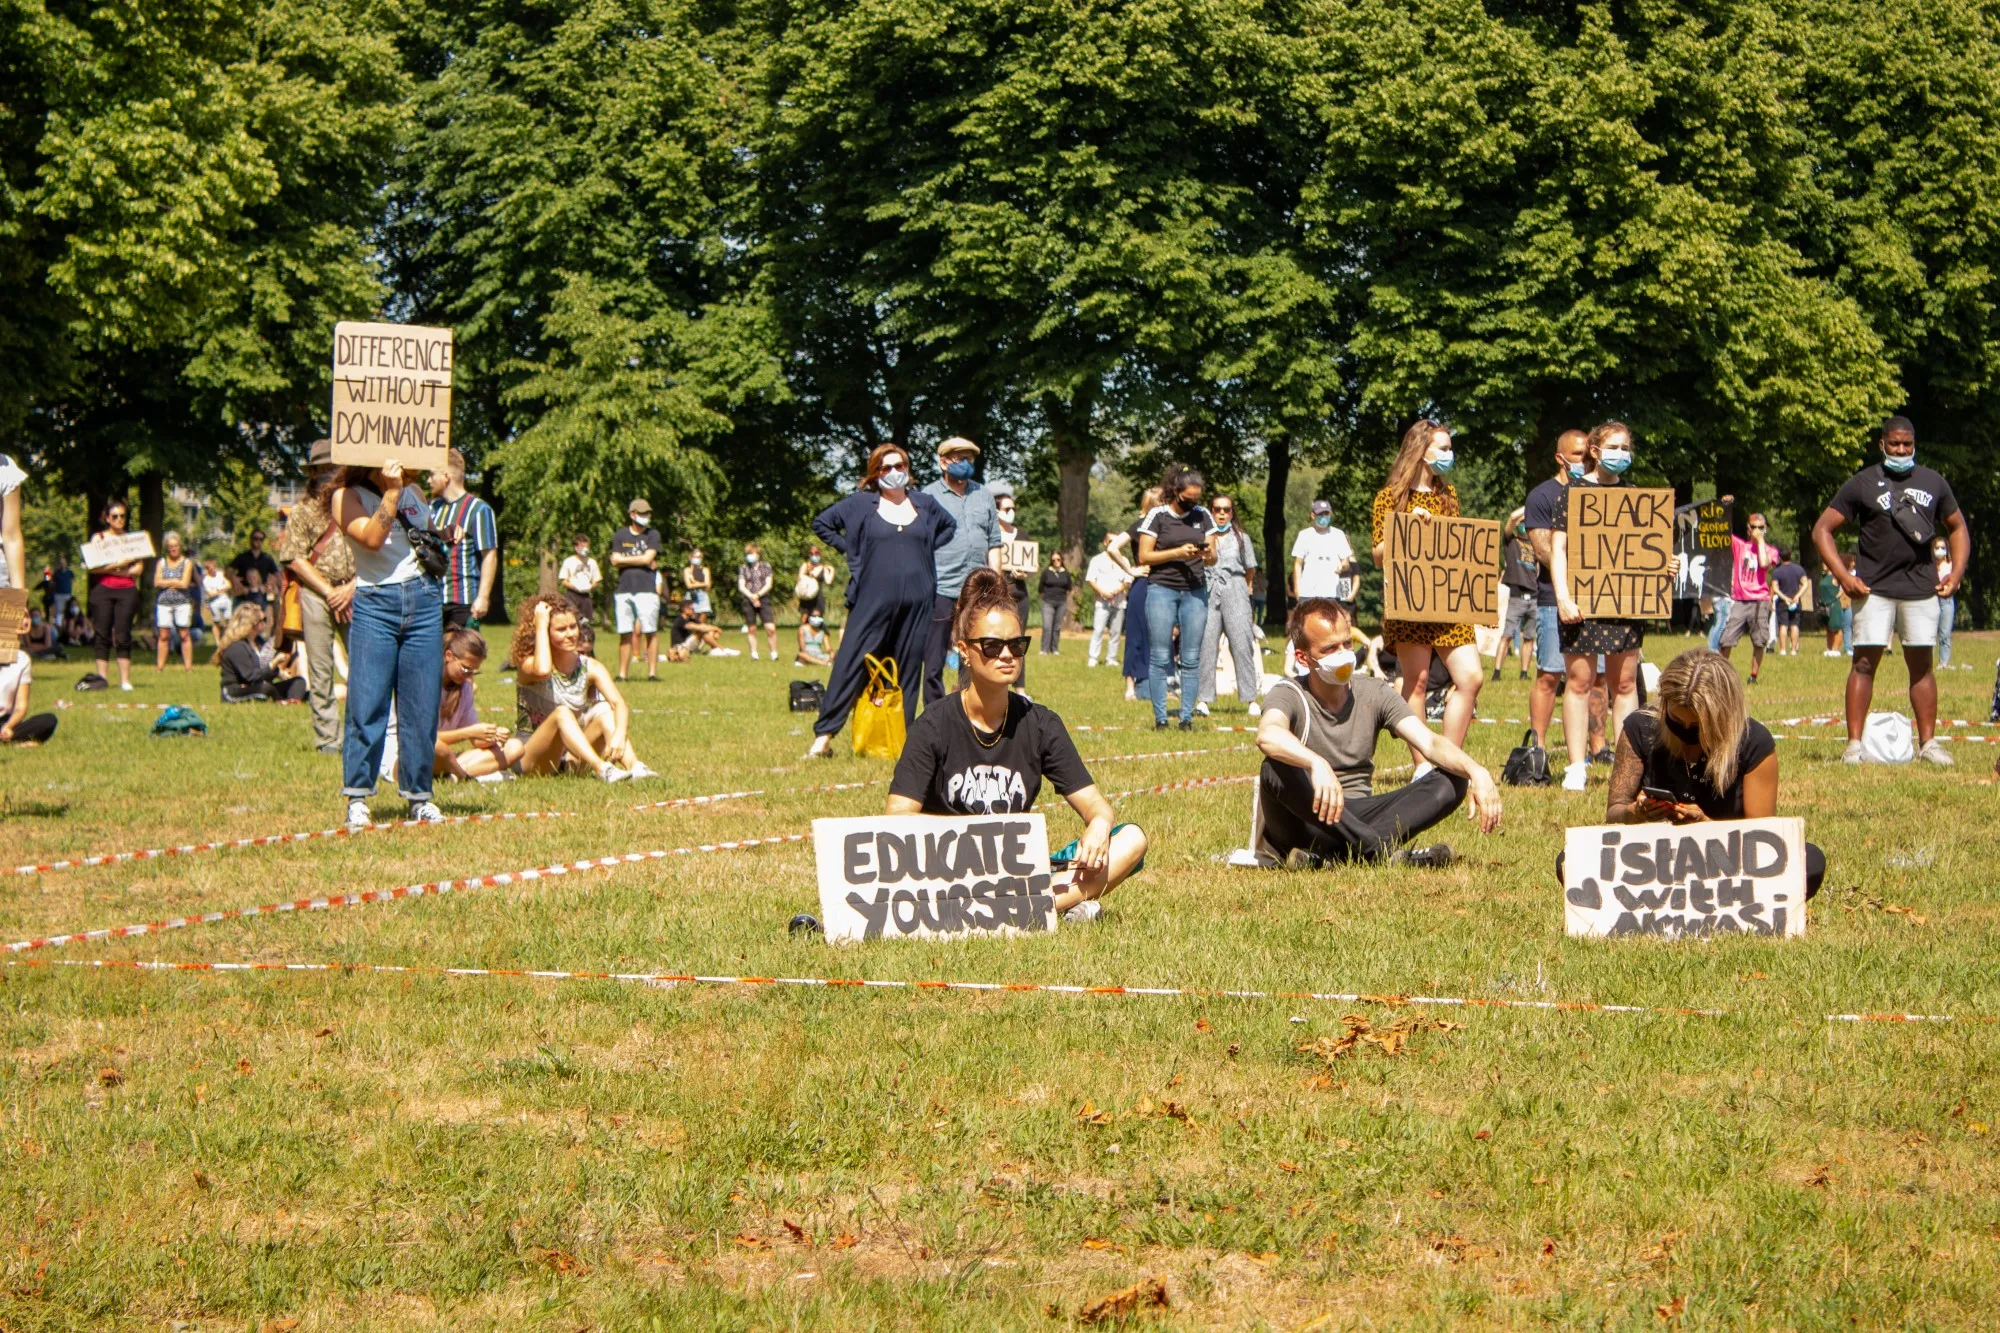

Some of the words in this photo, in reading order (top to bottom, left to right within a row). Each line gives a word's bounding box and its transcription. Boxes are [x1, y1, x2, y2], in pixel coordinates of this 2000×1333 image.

[337, 334, 452, 372] DIFFERENCE
[345, 375, 442, 408] WITHOUT
[336, 411, 450, 448] DOMINANCE
[1579, 493, 1671, 529] BLACK
[1391, 511, 1422, 561] NO
[1424, 521, 1498, 567] JUSTICE
[1580, 533, 1667, 572] LIVES
[1699, 533, 1731, 549] FLOYD
[1392, 561, 1426, 612] NO
[1431, 565, 1498, 613] PEACE
[1574, 573, 1671, 615] MATTER
[947, 764, 1027, 811] PATTA
[844, 821, 1035, 884] EDUCATE
[845, 873, 1054, 940] YOURSELF
